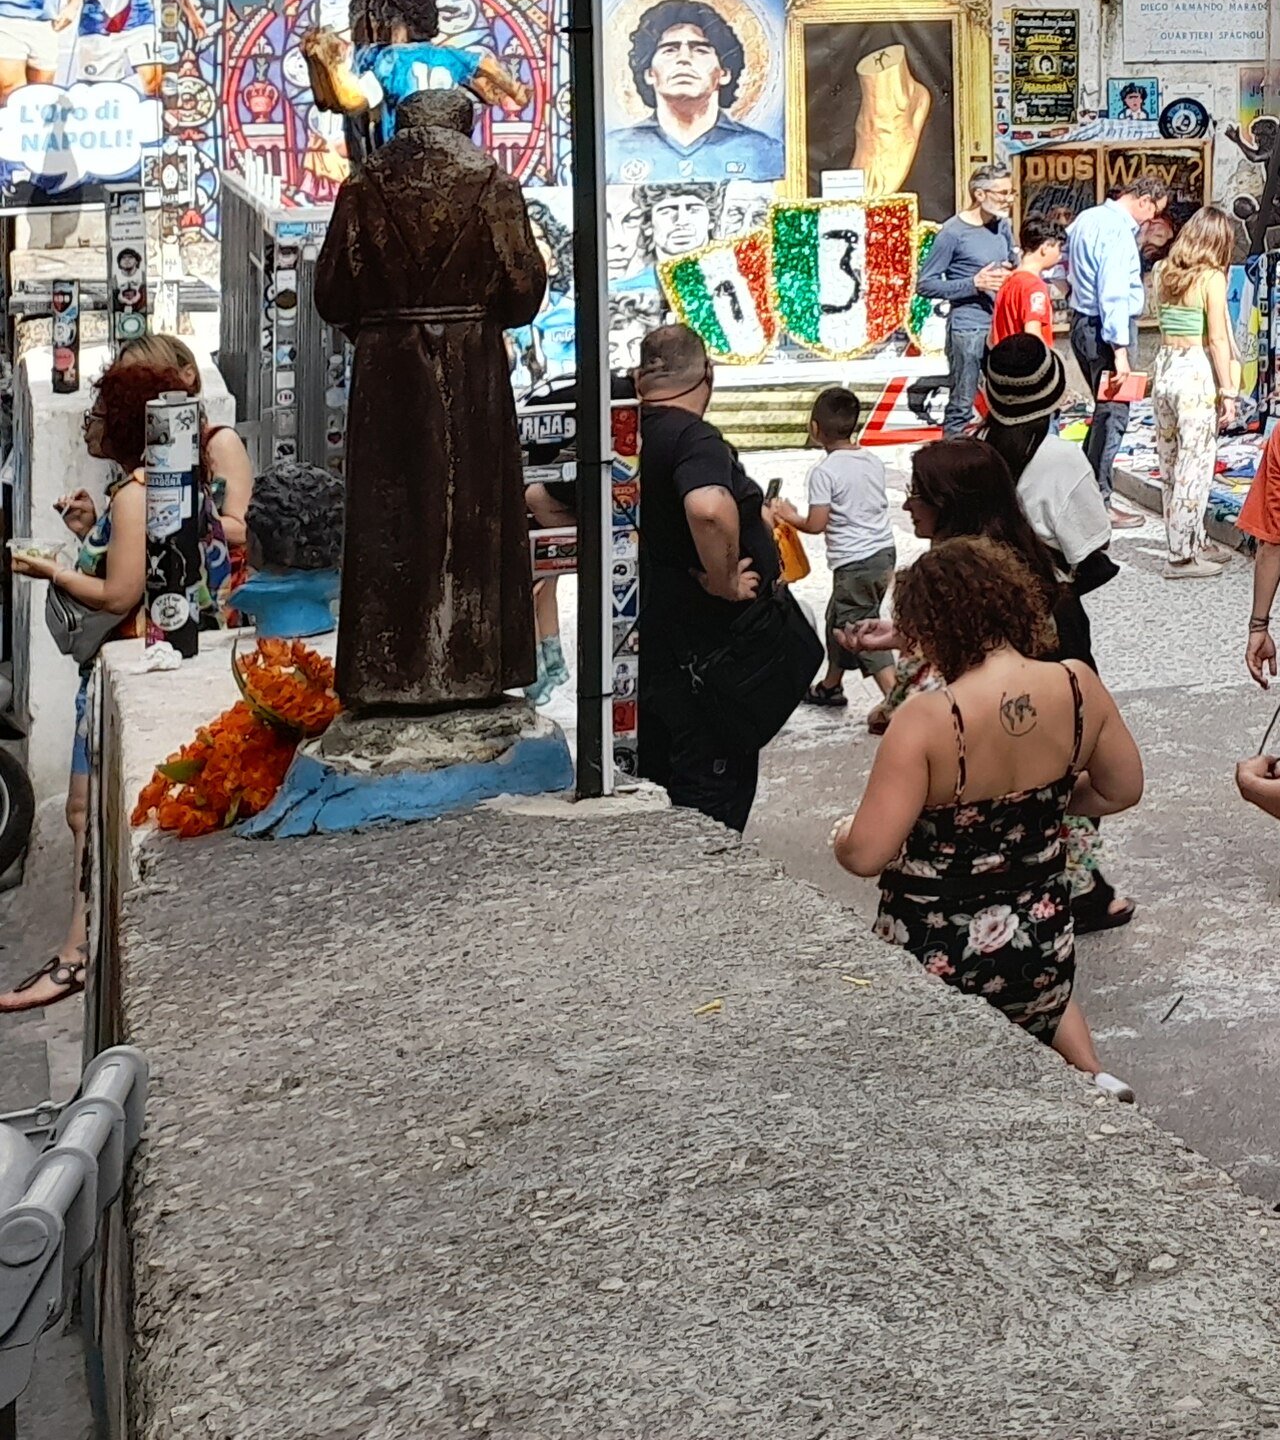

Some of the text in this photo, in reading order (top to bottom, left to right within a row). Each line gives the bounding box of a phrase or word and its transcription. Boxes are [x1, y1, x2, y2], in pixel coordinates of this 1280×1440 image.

[1141, 3, 1168, 11] DIEGO
[1175, 3, 1223, 11] ARMANDO
[1219, 31, 1264, 40] SPAGNOLI
[95, 100, 120, 120] di
[21, 129, 134, 153] NAPOLI!
[819, 229, 860, 313] 3
